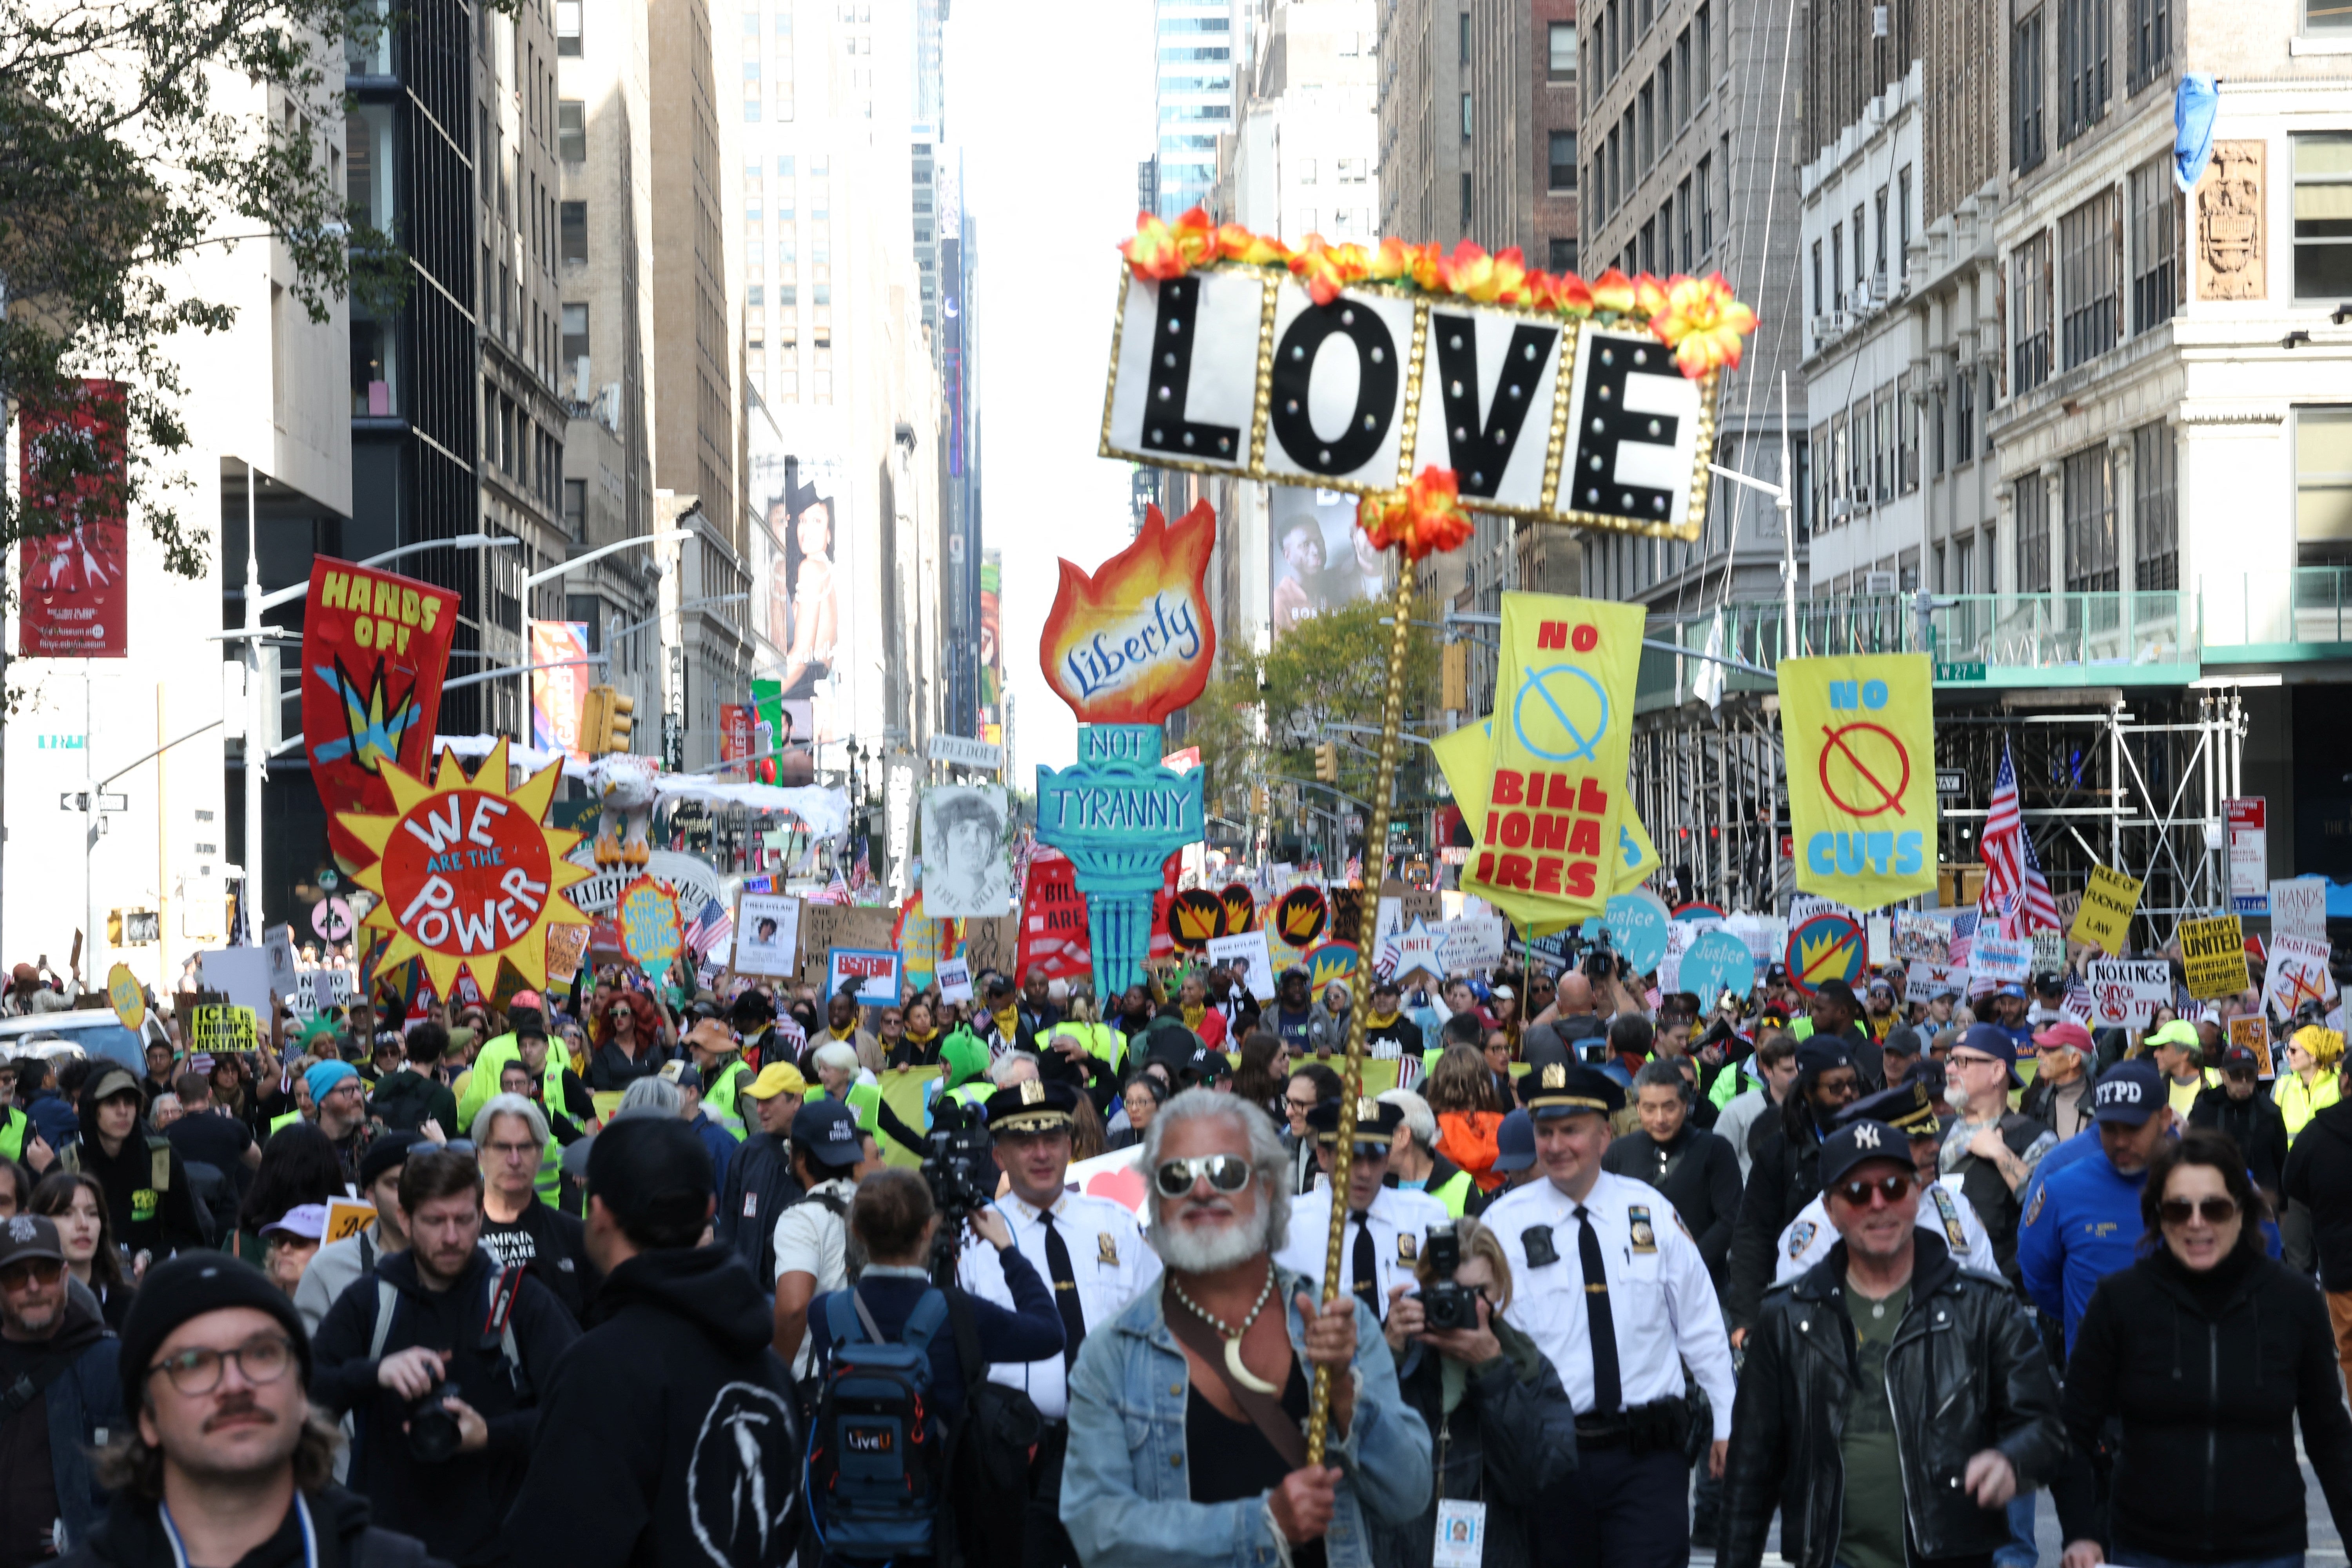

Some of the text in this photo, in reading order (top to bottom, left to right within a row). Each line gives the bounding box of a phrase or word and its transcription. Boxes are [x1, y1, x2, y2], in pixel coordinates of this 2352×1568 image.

[1140, 278, 1684, 522] LOVE
[321, 571, 441, 634] HANDS
[354, 615, 410, 656] OFF
[1068, 589, 1199, 700] Liberty
[1537, 620, 1598, 653] NO
[1942, 664, 1950, 680] W
[1955, 664, 1968, 680] 27
[1829, 679, 1888, 711] NO
[1089, 728, 1146, 760] NOT
[1491, 769, 1608, 815] BILL
[1050, 787, 1191, 831] TYRANNY
[404, 794, 508, 854] WE
[1484, 811, 1601, 857] IONA
[427, 847, 505, 874] ARE THE
[1807, 830, 1923, 876] CUTS
[1475, 852, 1597, 899] IRES
[399, 867, 546, 953] POWER
[633, 890, 657, 904] NO
[2086, 889, 2134, 918] FUCKING
[2278, 886, 2323, 909] HANDS
[624, 898, 673, 924] KINGS
[2085, 916, 2112, 937] LAW
[2182, 923, 2199, 936] THE
[1401, 936, 1432, 954] UNITE
[1695, 939, 1746, 967] Justice
[2183, 932, 2242, 957] UNITED
[1710, 964, 1723, 983] 4
[2095, 962, 2167, 984] NO KINGS
[2186, 962, 2199, 972] CAN
[2229, 956, 2244, 966] THE
[198, 1006, 235, 1021] ICE
[299, 991, 352, 1009] FAISM
[2096, 1080, 2142, 1107] NYPD
[848, 1429, 891, 1450] LiveU
